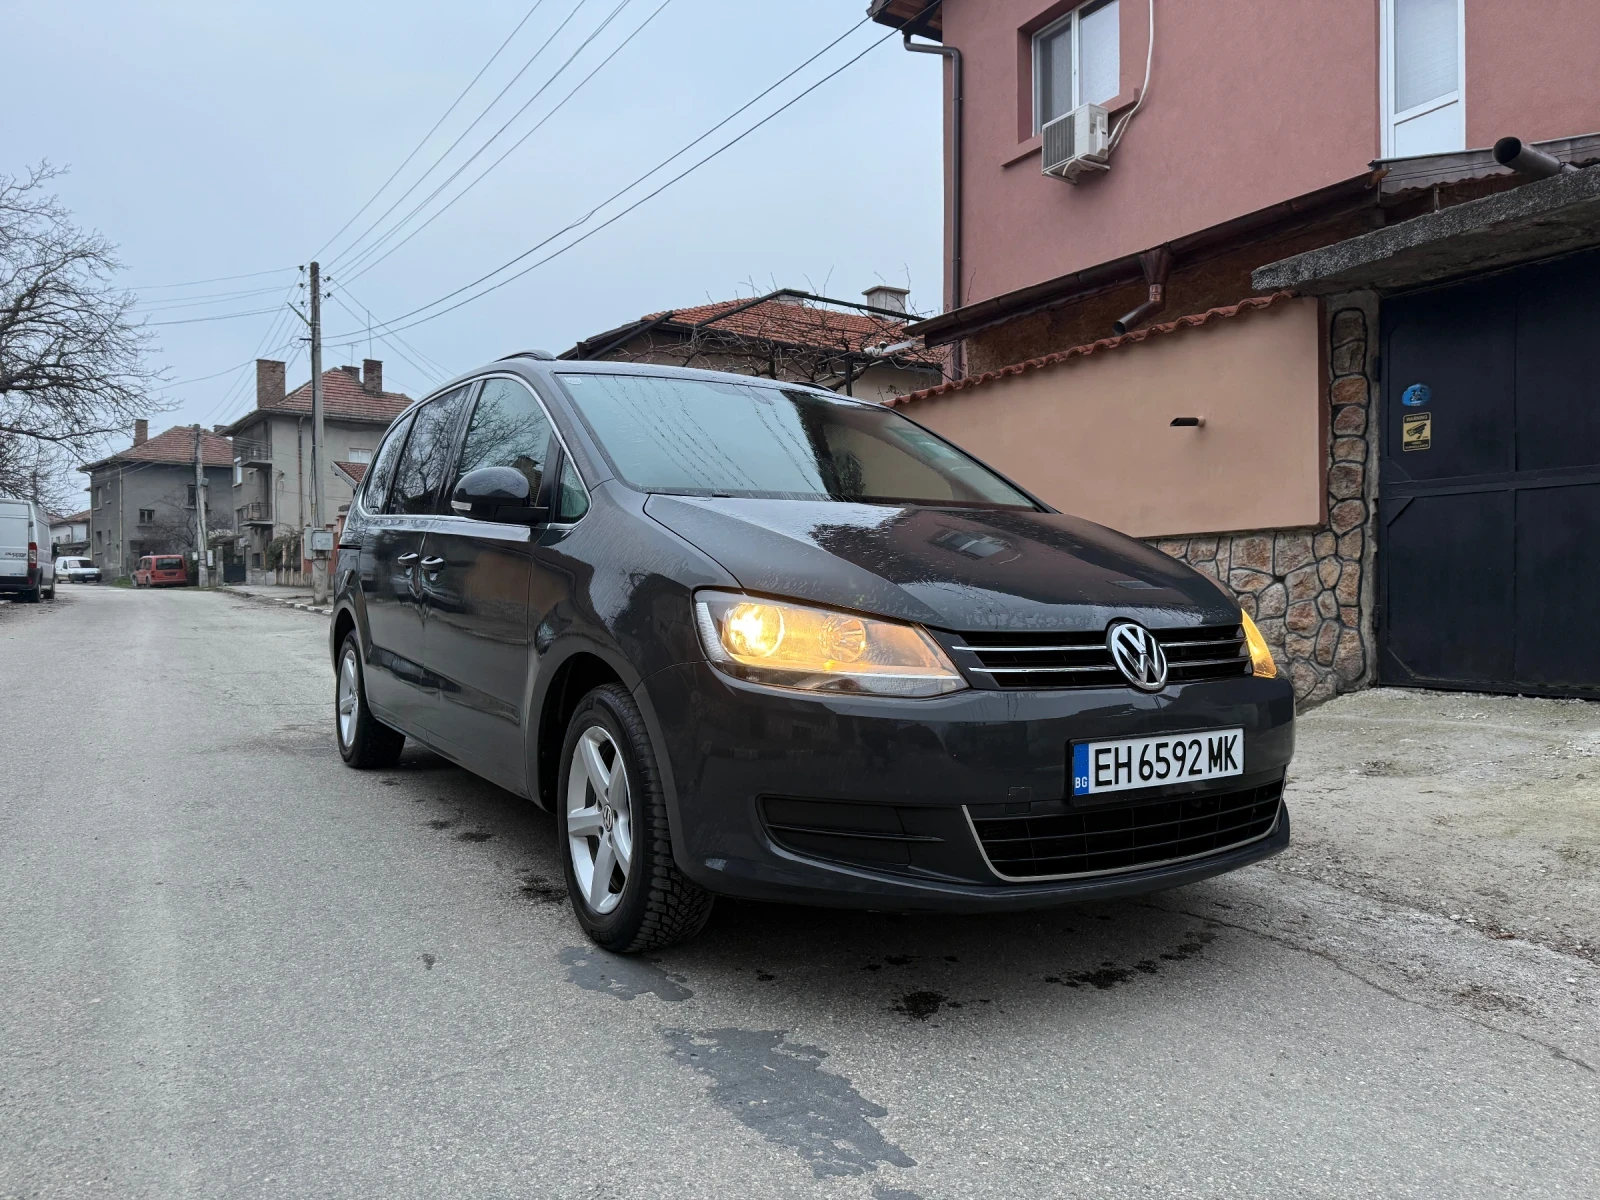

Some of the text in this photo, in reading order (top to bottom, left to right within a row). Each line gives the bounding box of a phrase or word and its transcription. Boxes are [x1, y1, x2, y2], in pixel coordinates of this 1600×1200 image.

[1112, 624, 1166, 689] VW
[1075, 776, 1088, 789] BG
[1094, 734, 1238, 787] EH 6592 MK
